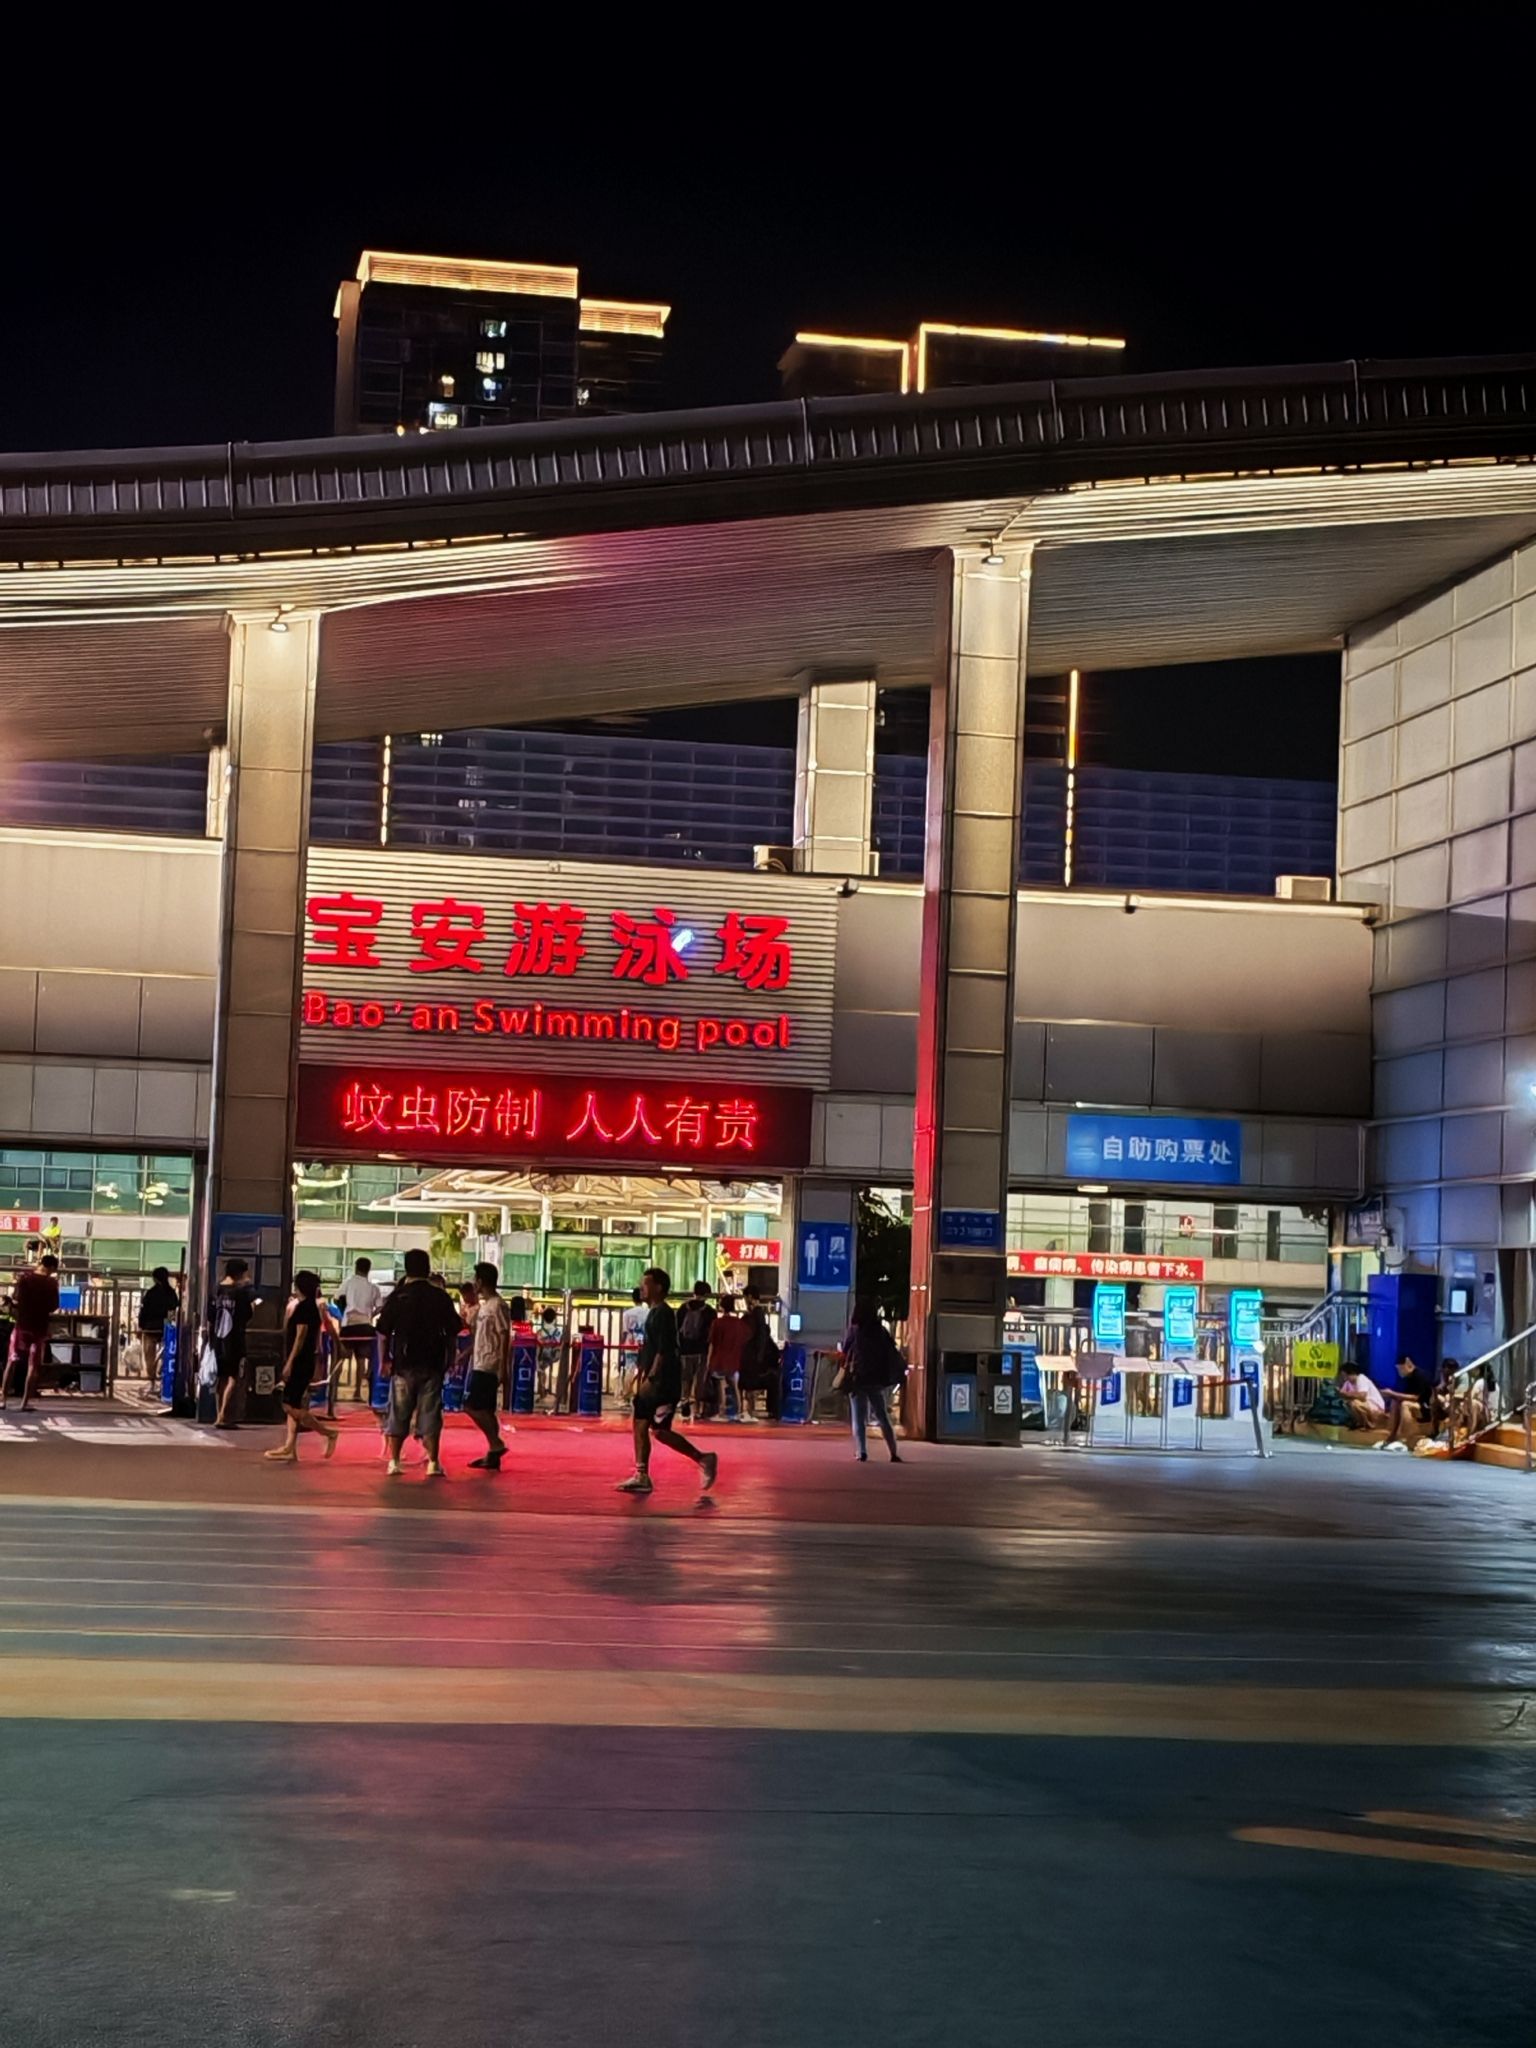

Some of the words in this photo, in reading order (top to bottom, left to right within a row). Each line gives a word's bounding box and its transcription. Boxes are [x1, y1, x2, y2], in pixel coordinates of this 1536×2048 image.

[305, 892, 793, 990] 宝安游泳场
[305, 990, 460, 1031] Bao'an
[473, 1000, 680, 1049] Swimming
[697, 1013, 791, 1050] pool
[343, 1082, 541, 1137] 蚊虫防制
[566, 1091, 758, 1149] 人人有责
[1103, 1136, 1233, 1165] 自助购票处
